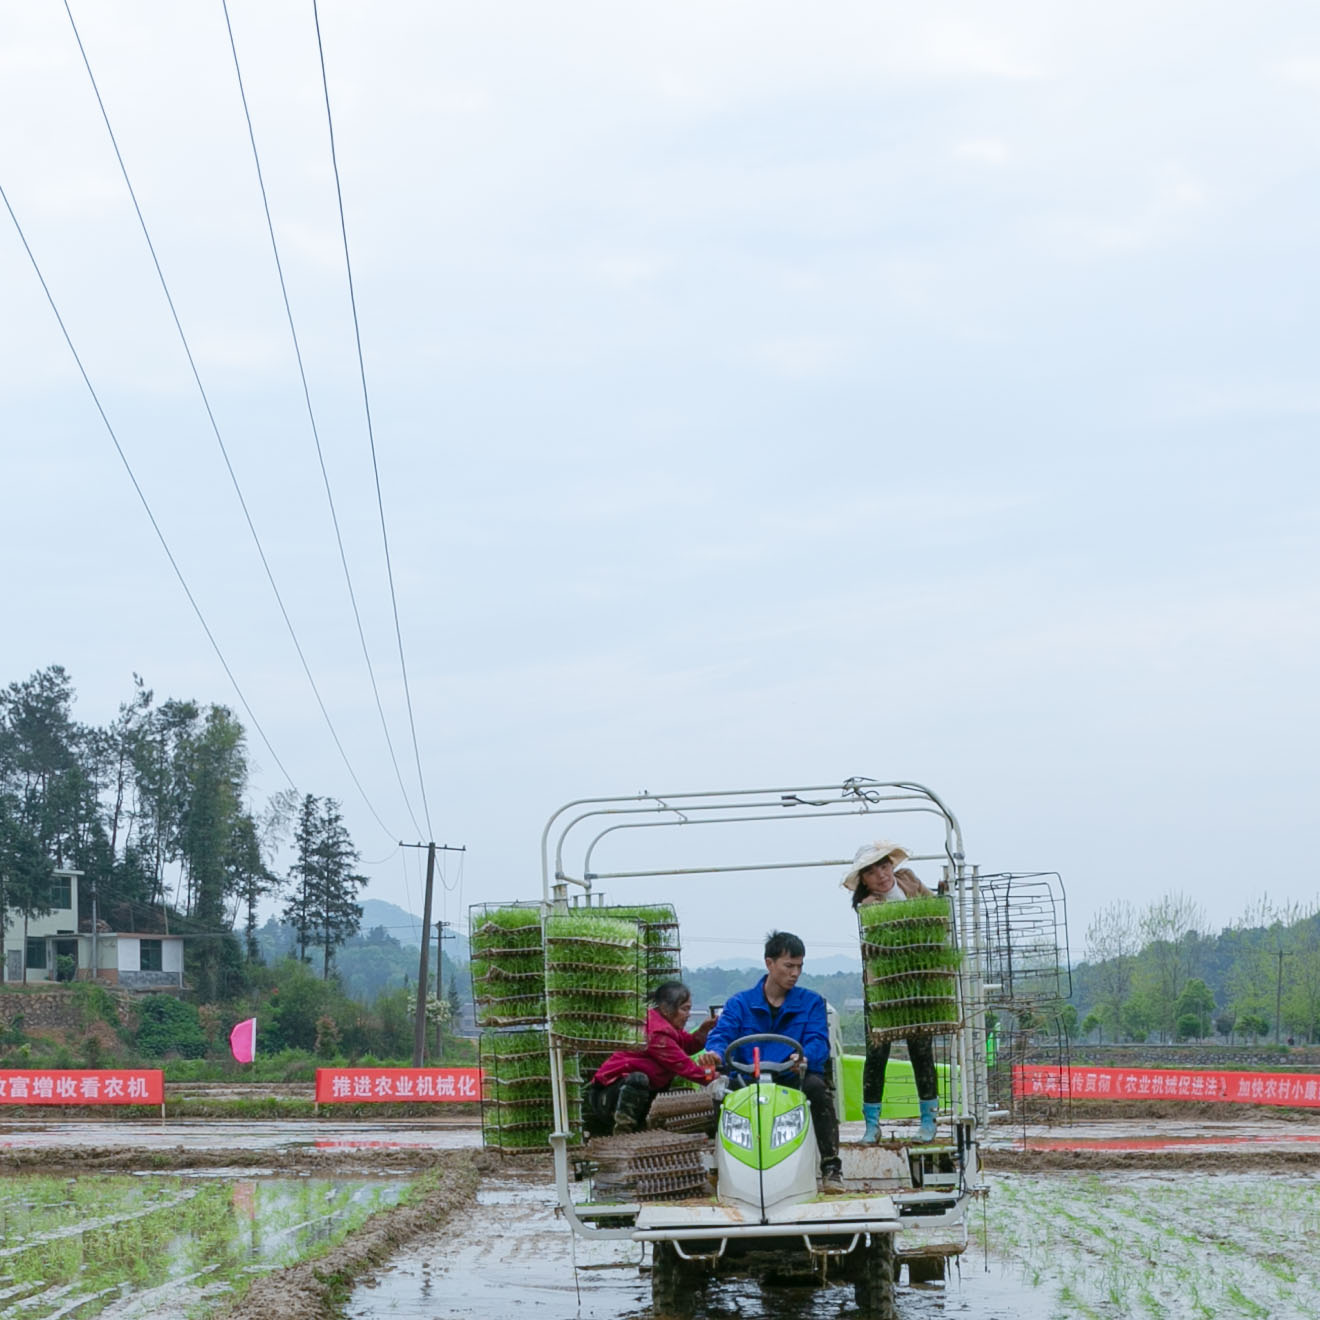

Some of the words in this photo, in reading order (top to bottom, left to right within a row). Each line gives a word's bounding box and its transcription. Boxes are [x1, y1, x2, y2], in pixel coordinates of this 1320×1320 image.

[332, 1075, 476, 1098] 推进农业机械化
